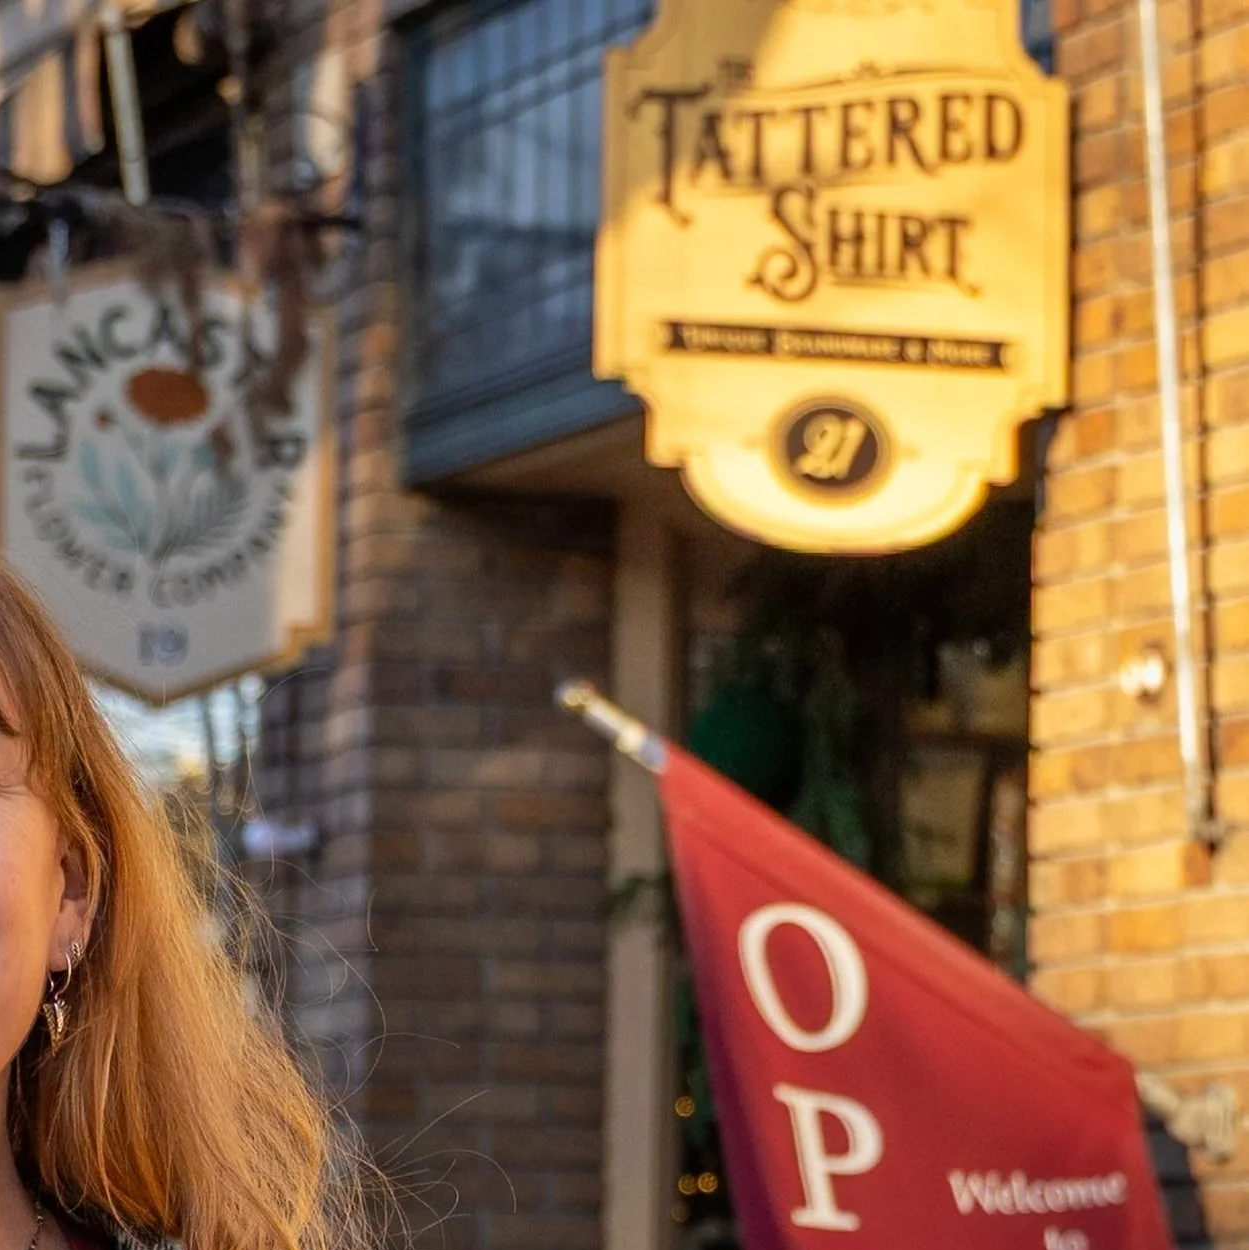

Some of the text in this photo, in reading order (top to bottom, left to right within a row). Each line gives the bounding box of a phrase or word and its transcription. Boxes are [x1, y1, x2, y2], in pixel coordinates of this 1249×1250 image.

[626, 83, 1025, 228] TATTERED
[745, 181, 982, 302] SHIRT
[948, 1168, 1126, 1215] Welcome
